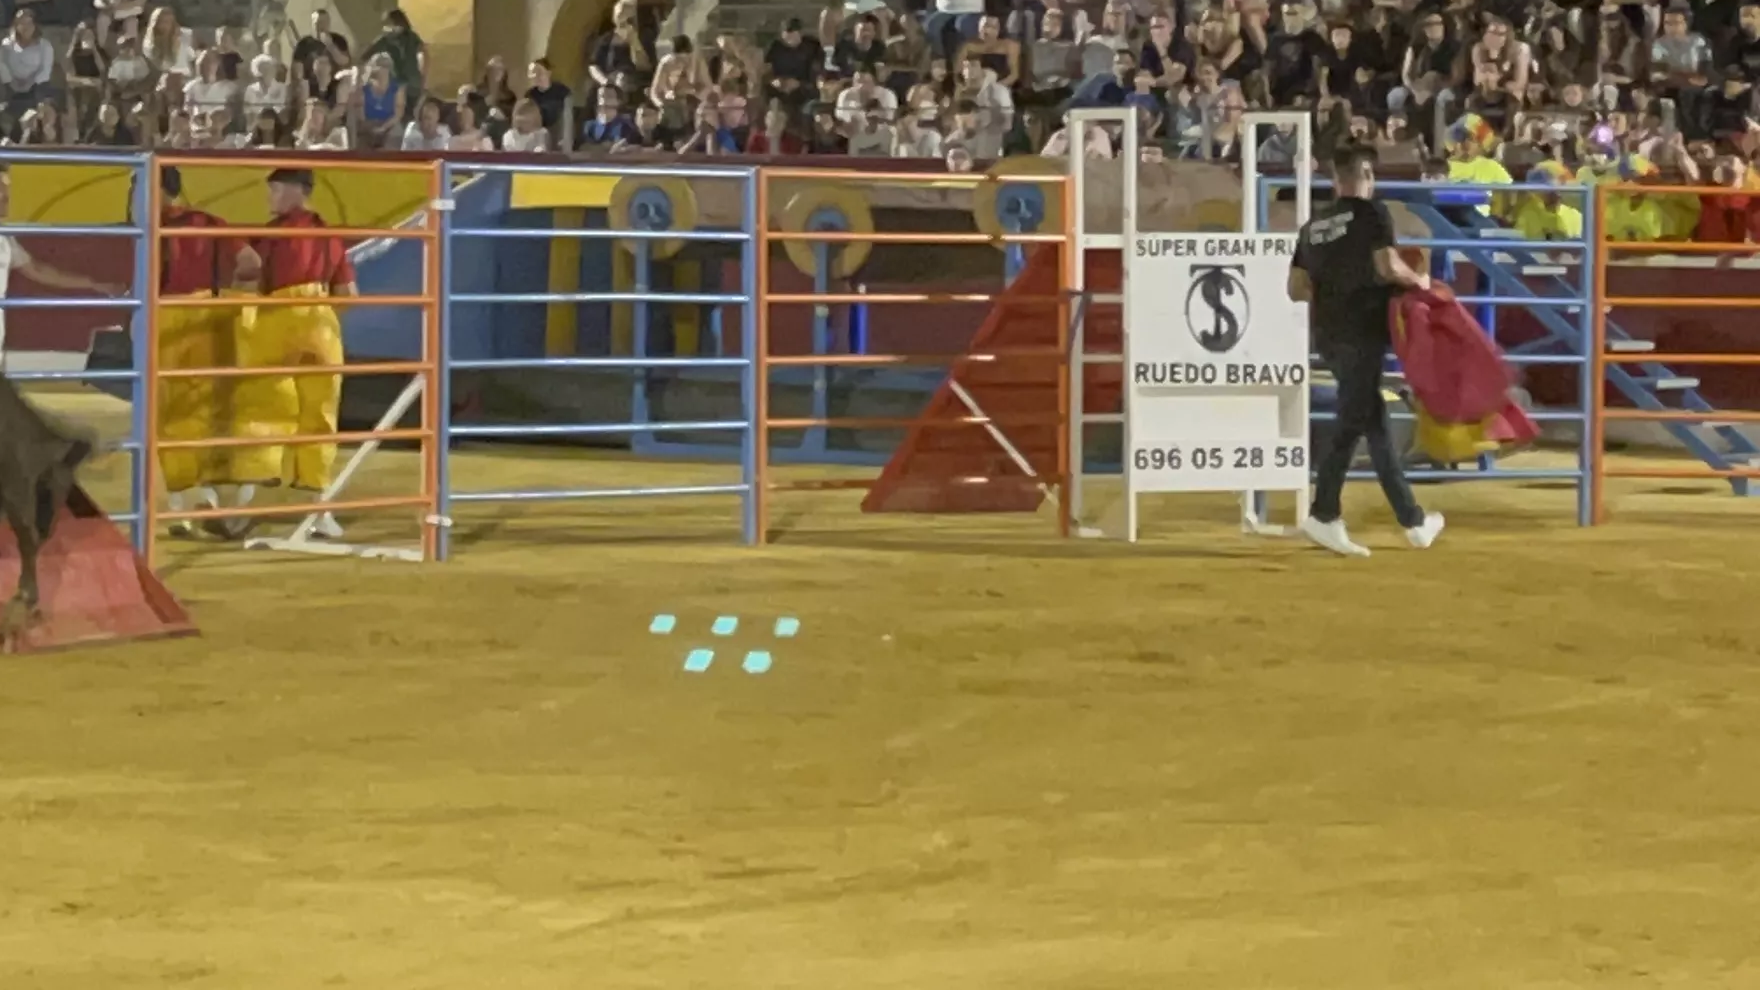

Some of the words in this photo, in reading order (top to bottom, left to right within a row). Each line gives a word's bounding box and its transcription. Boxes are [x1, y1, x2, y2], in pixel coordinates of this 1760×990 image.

[1135, 239, 1197, 257] SUPER
[1204, 239, 1256, 257] GRAN
[1134, 363, 1218, 384] RUEDO
[1225, 363, 1306, 385] BRAVO
[1134, 449, 1182, 470] 696
[1191, 449, 1224, 470] 05
[1233, 447, 1264, 468] 28
[1274, 446, 1305, 468] 58
